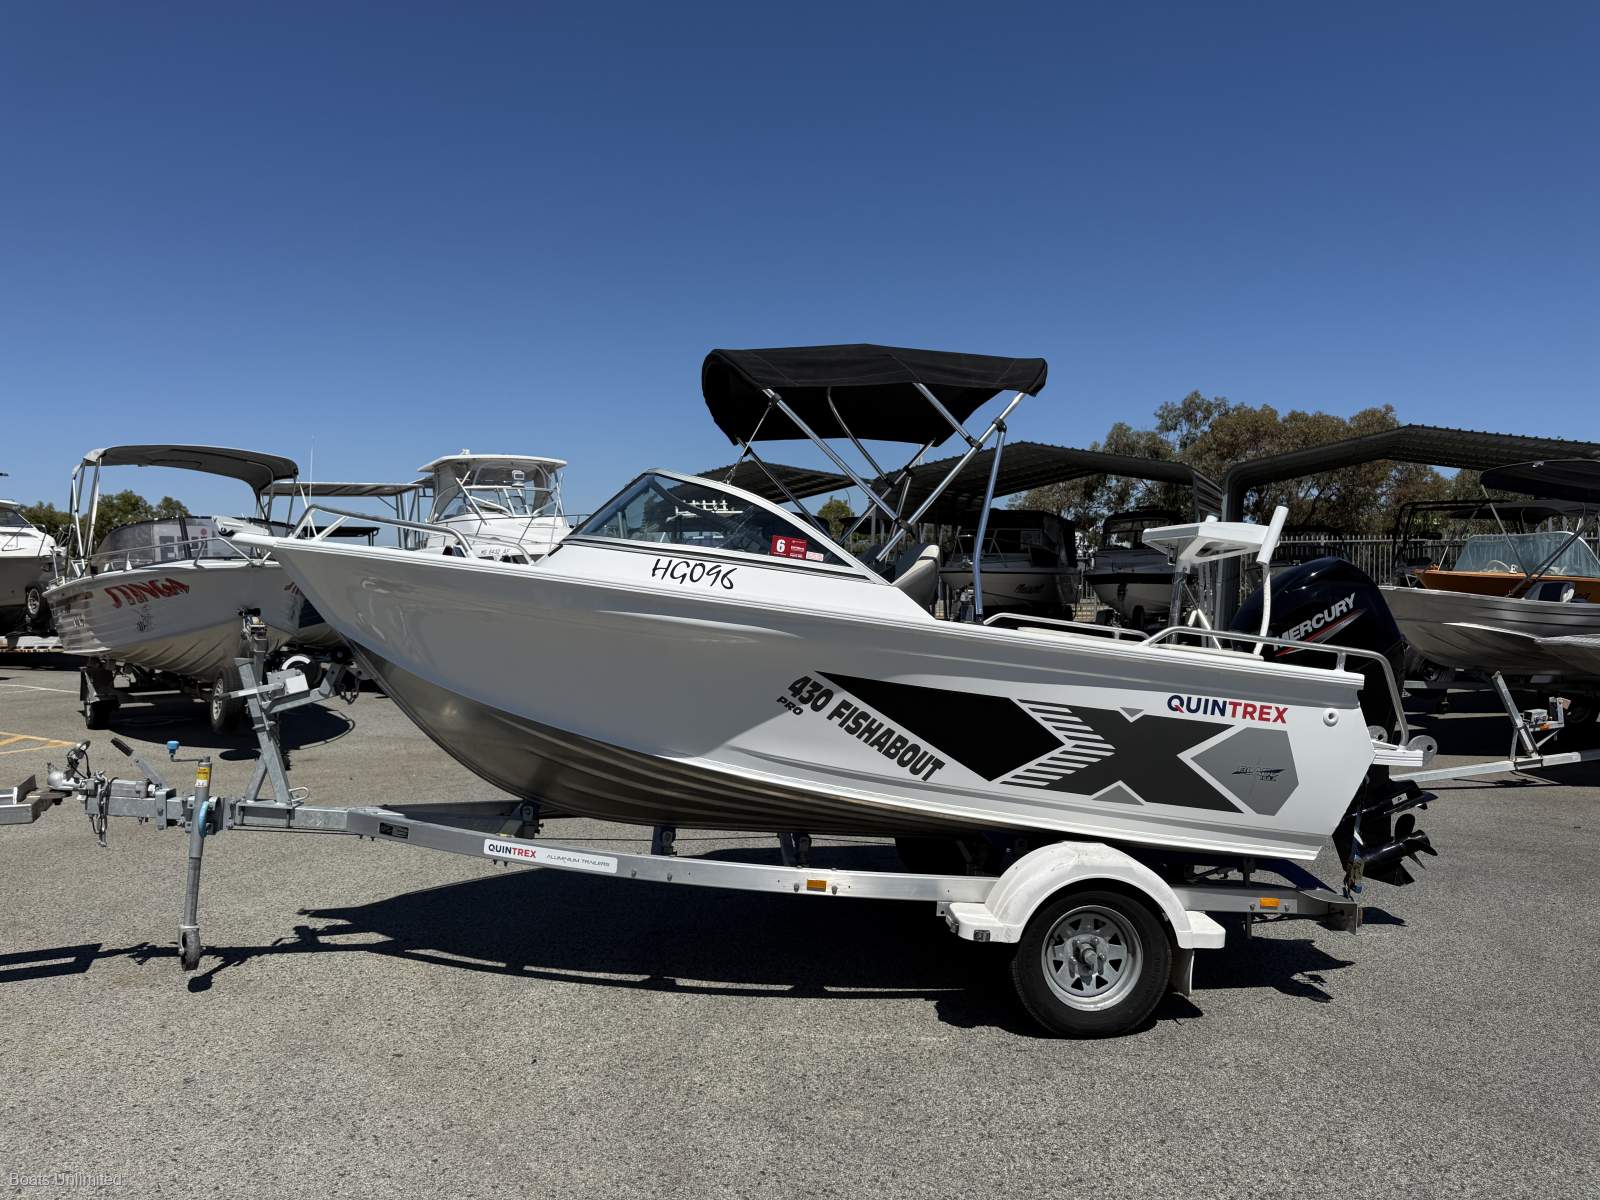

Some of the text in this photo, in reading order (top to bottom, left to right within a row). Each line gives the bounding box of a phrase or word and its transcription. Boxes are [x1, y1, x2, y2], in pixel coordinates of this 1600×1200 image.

[776, 539, 786, 553] 6
[651, 558, 738, 590] HG096
[776, 695, 804, 716] PRO
[1166, 694, 1289, 724] QUINTREX
[787, 675, 946, 782] 430 FISHABOUT
[488, 843, 537, 859] QUINTREX
